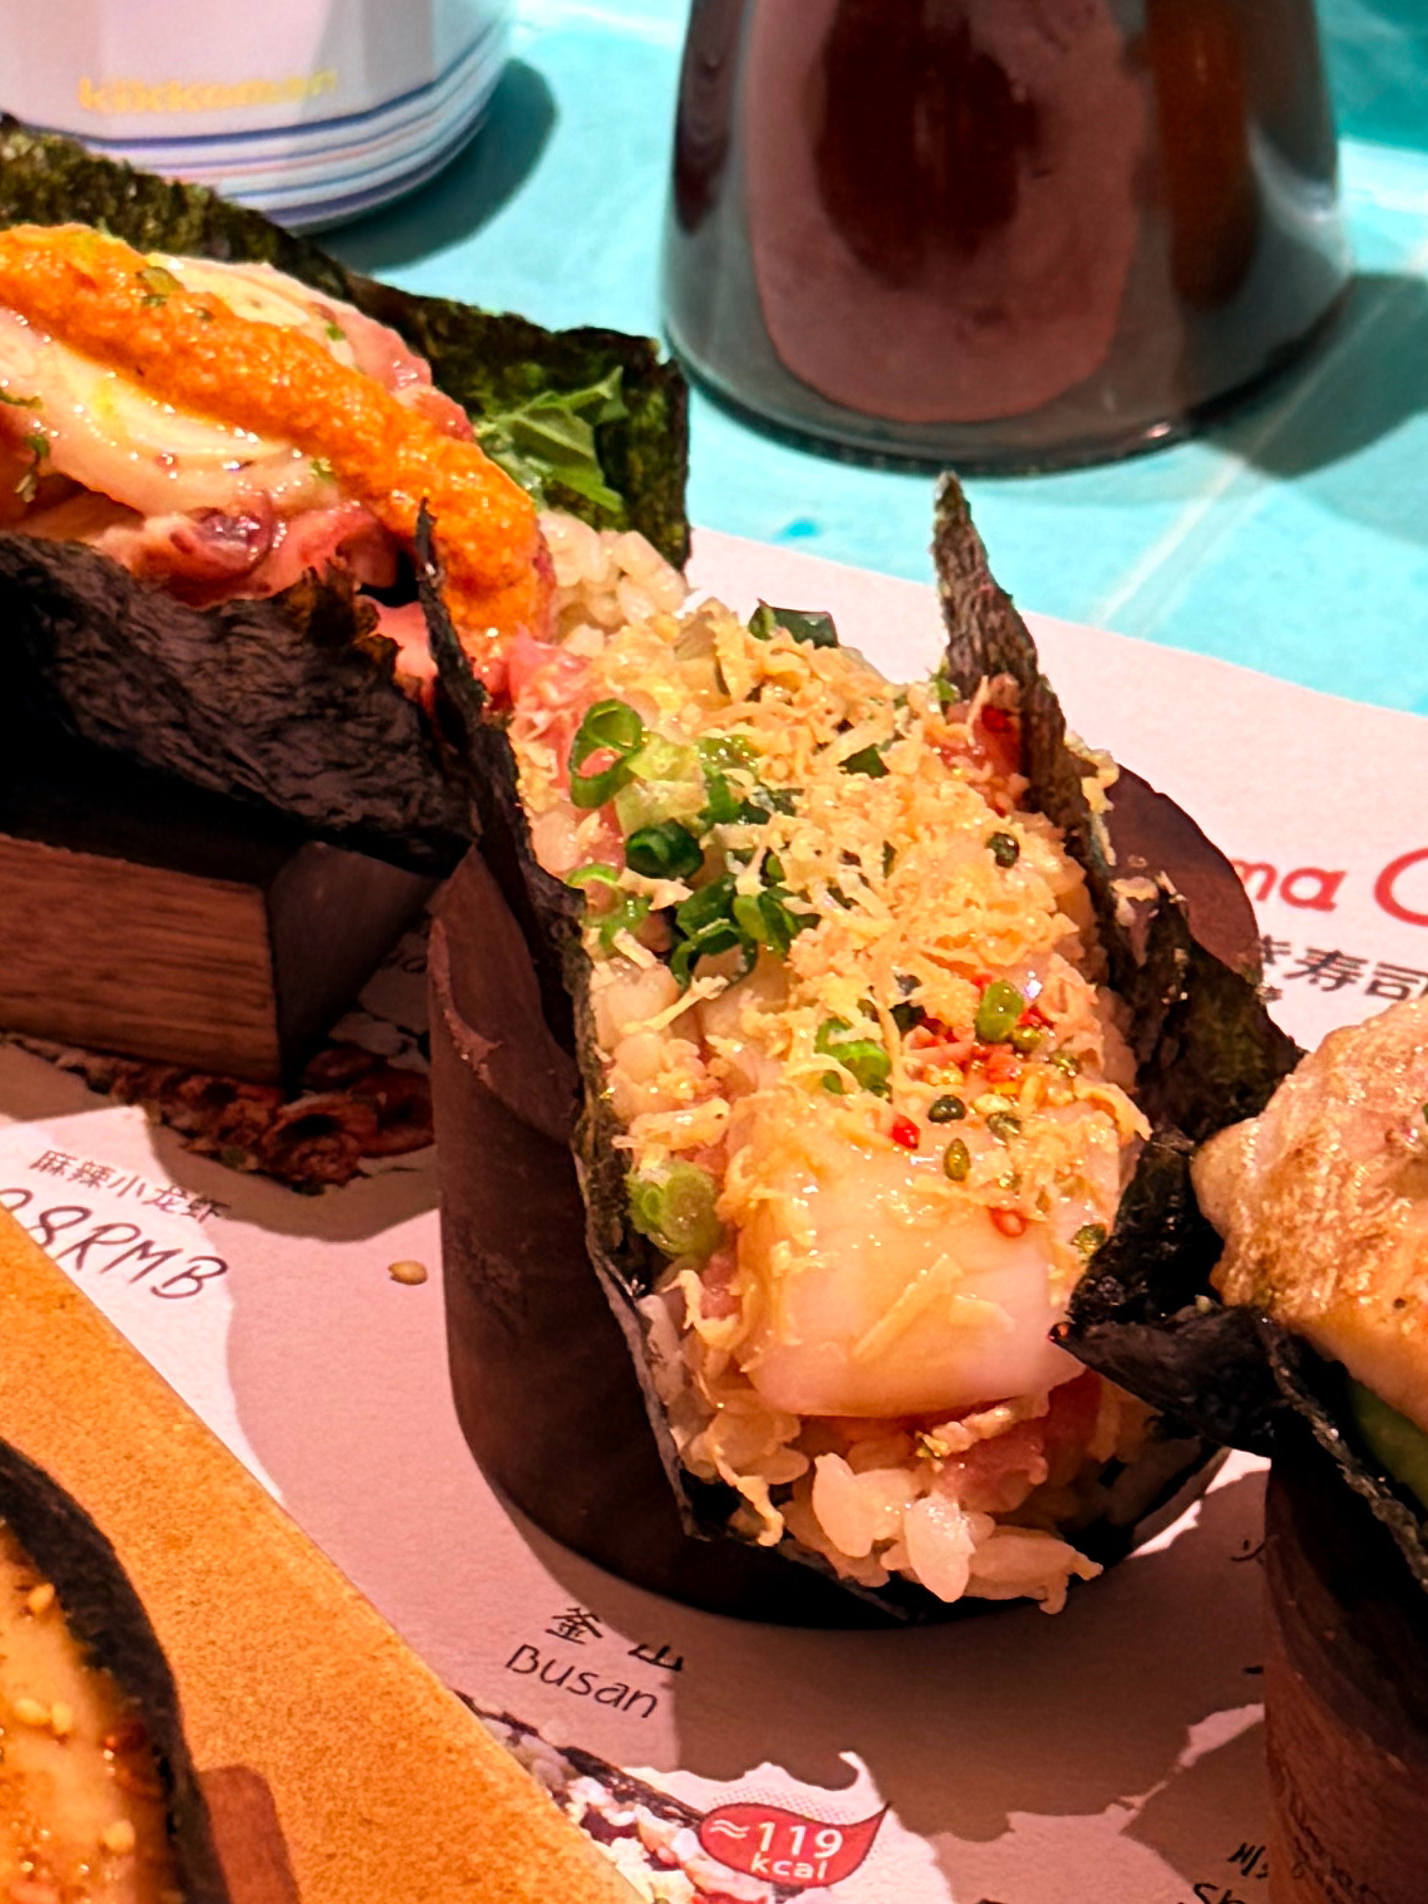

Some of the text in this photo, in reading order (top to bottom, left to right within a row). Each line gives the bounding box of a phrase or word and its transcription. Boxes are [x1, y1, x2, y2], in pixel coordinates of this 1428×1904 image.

[29, 1150, 232, 1224] 麻辣小龙虾
[549, 1605, 684, 1673] 釜山
[506, 1641, 660, 1720] Busan
[750, 1851, 828, 1881] kcal
